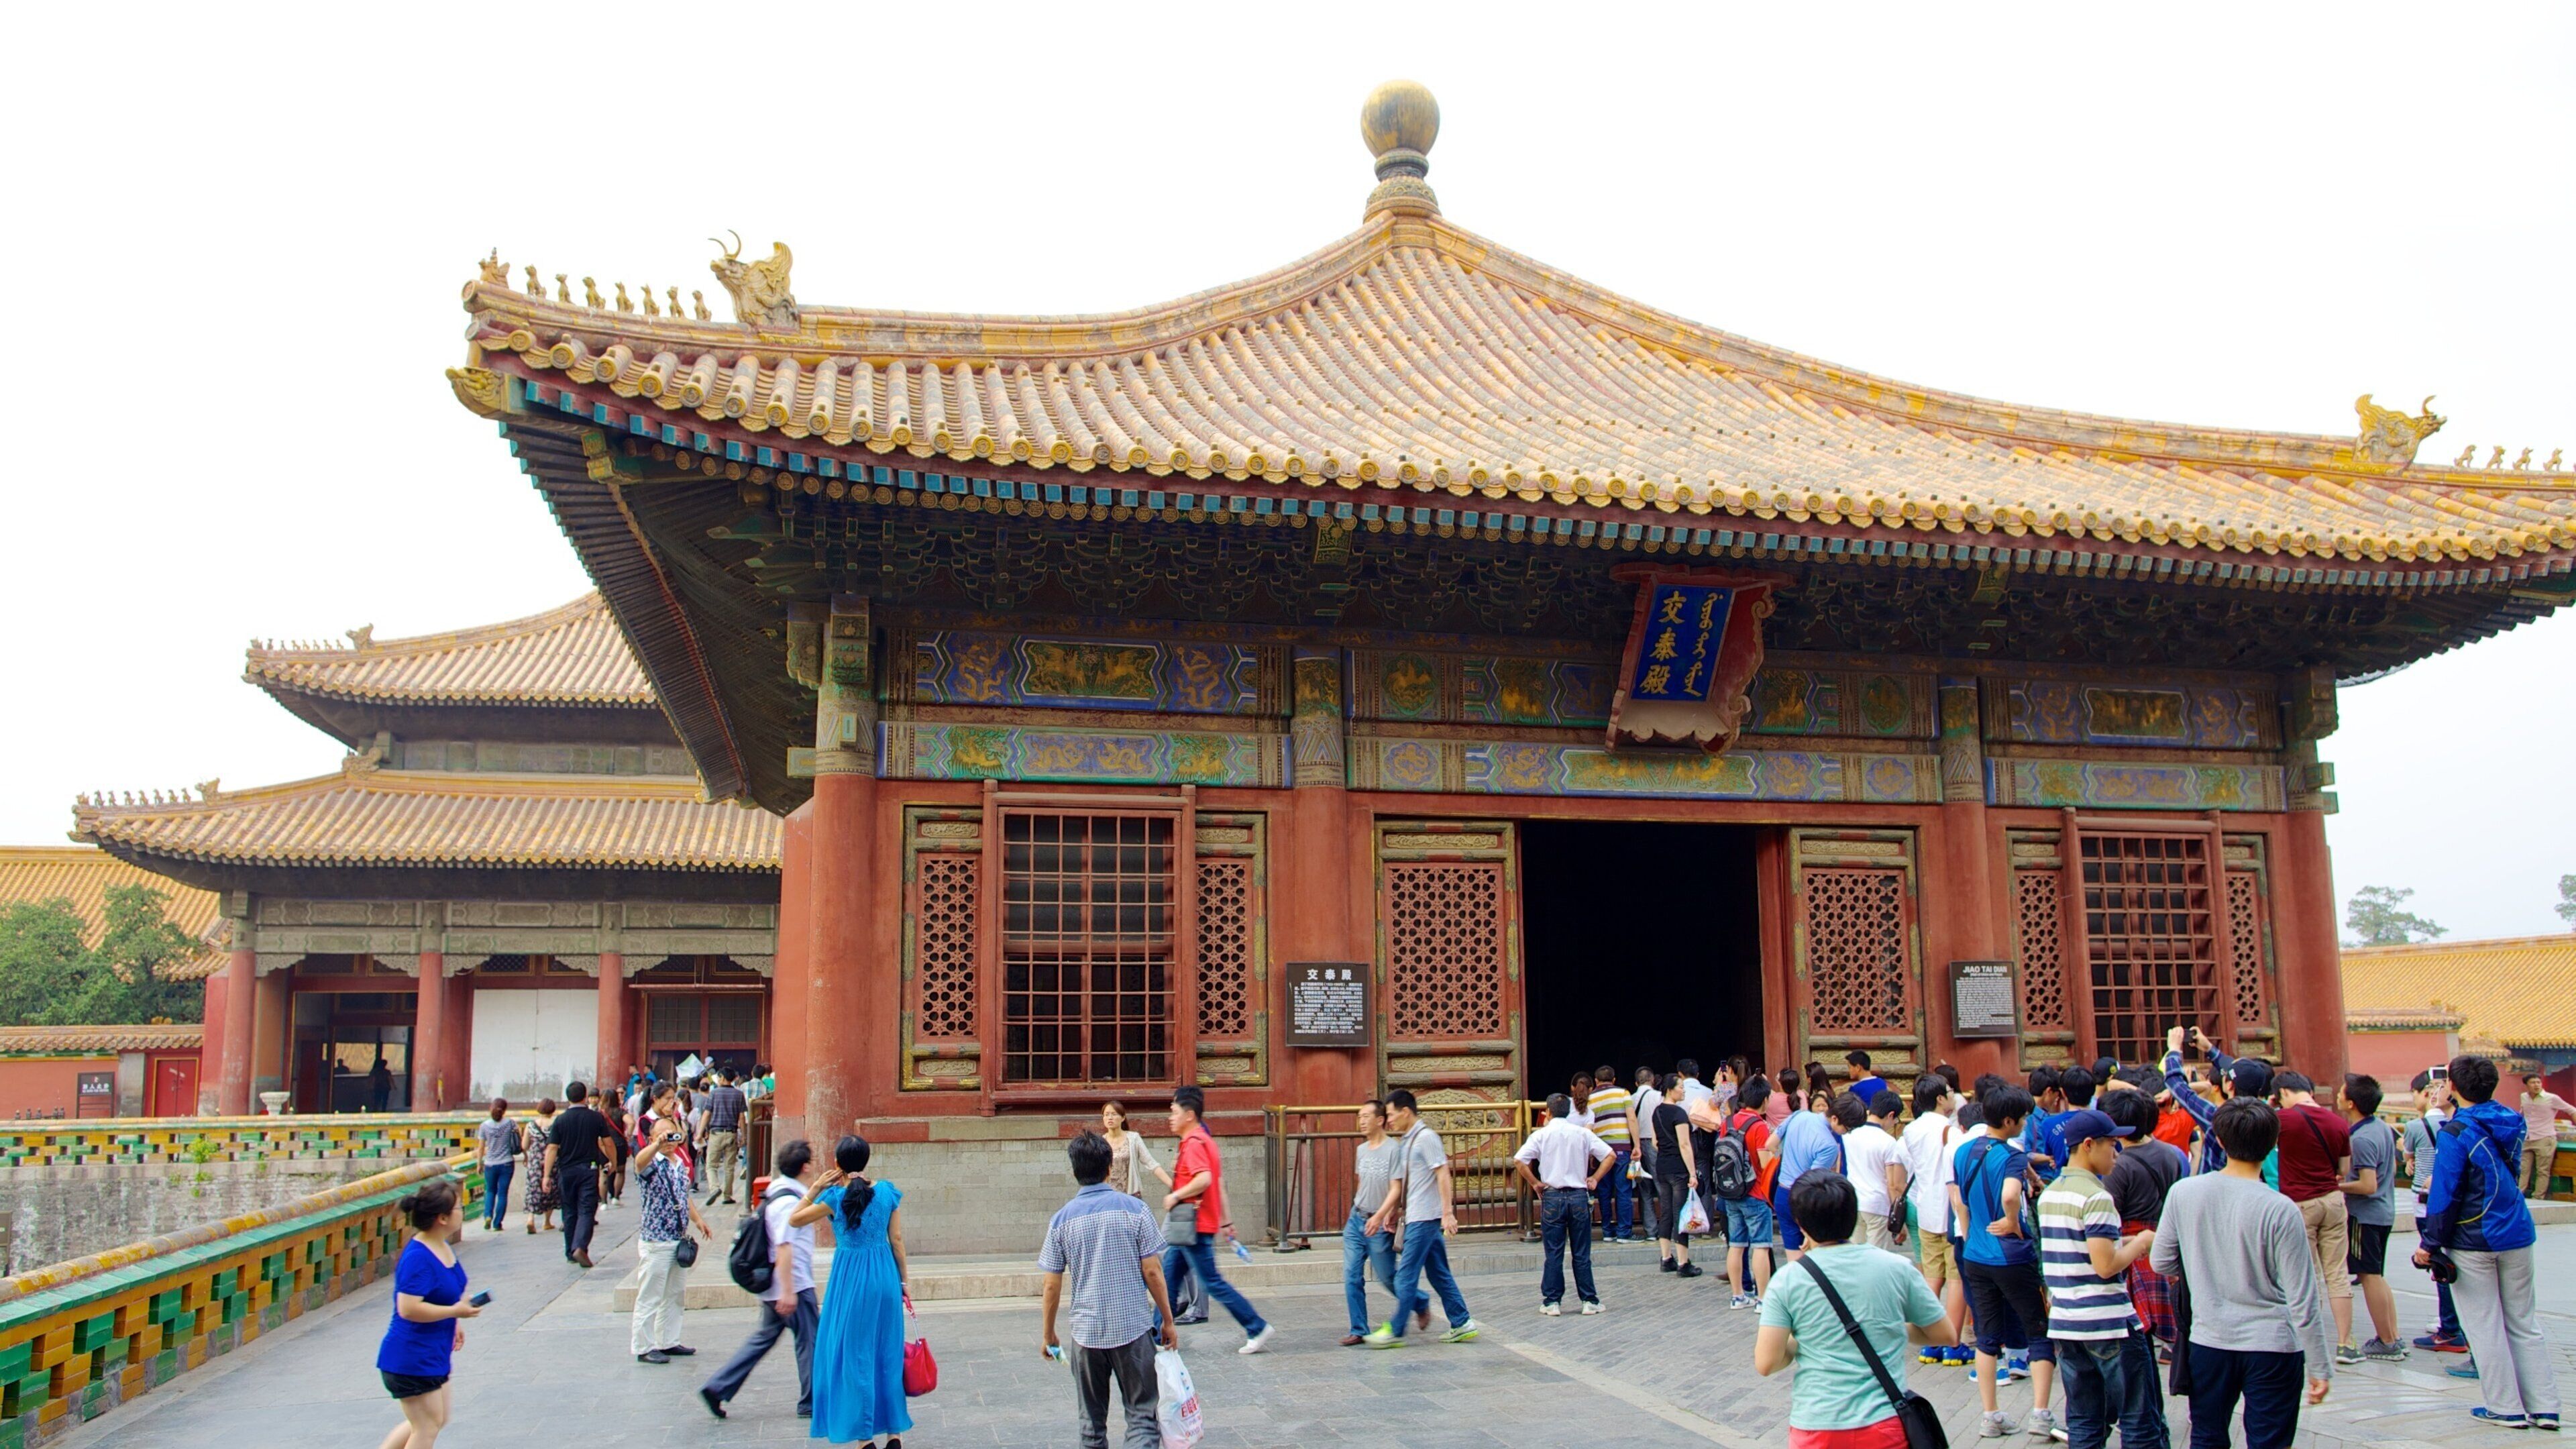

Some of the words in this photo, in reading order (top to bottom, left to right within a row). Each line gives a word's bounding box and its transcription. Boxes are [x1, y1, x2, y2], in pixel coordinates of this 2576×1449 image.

[1640, 590, 1687, 694] 交泰殿
[1307, 968, 1352, 981] 交泰殿
